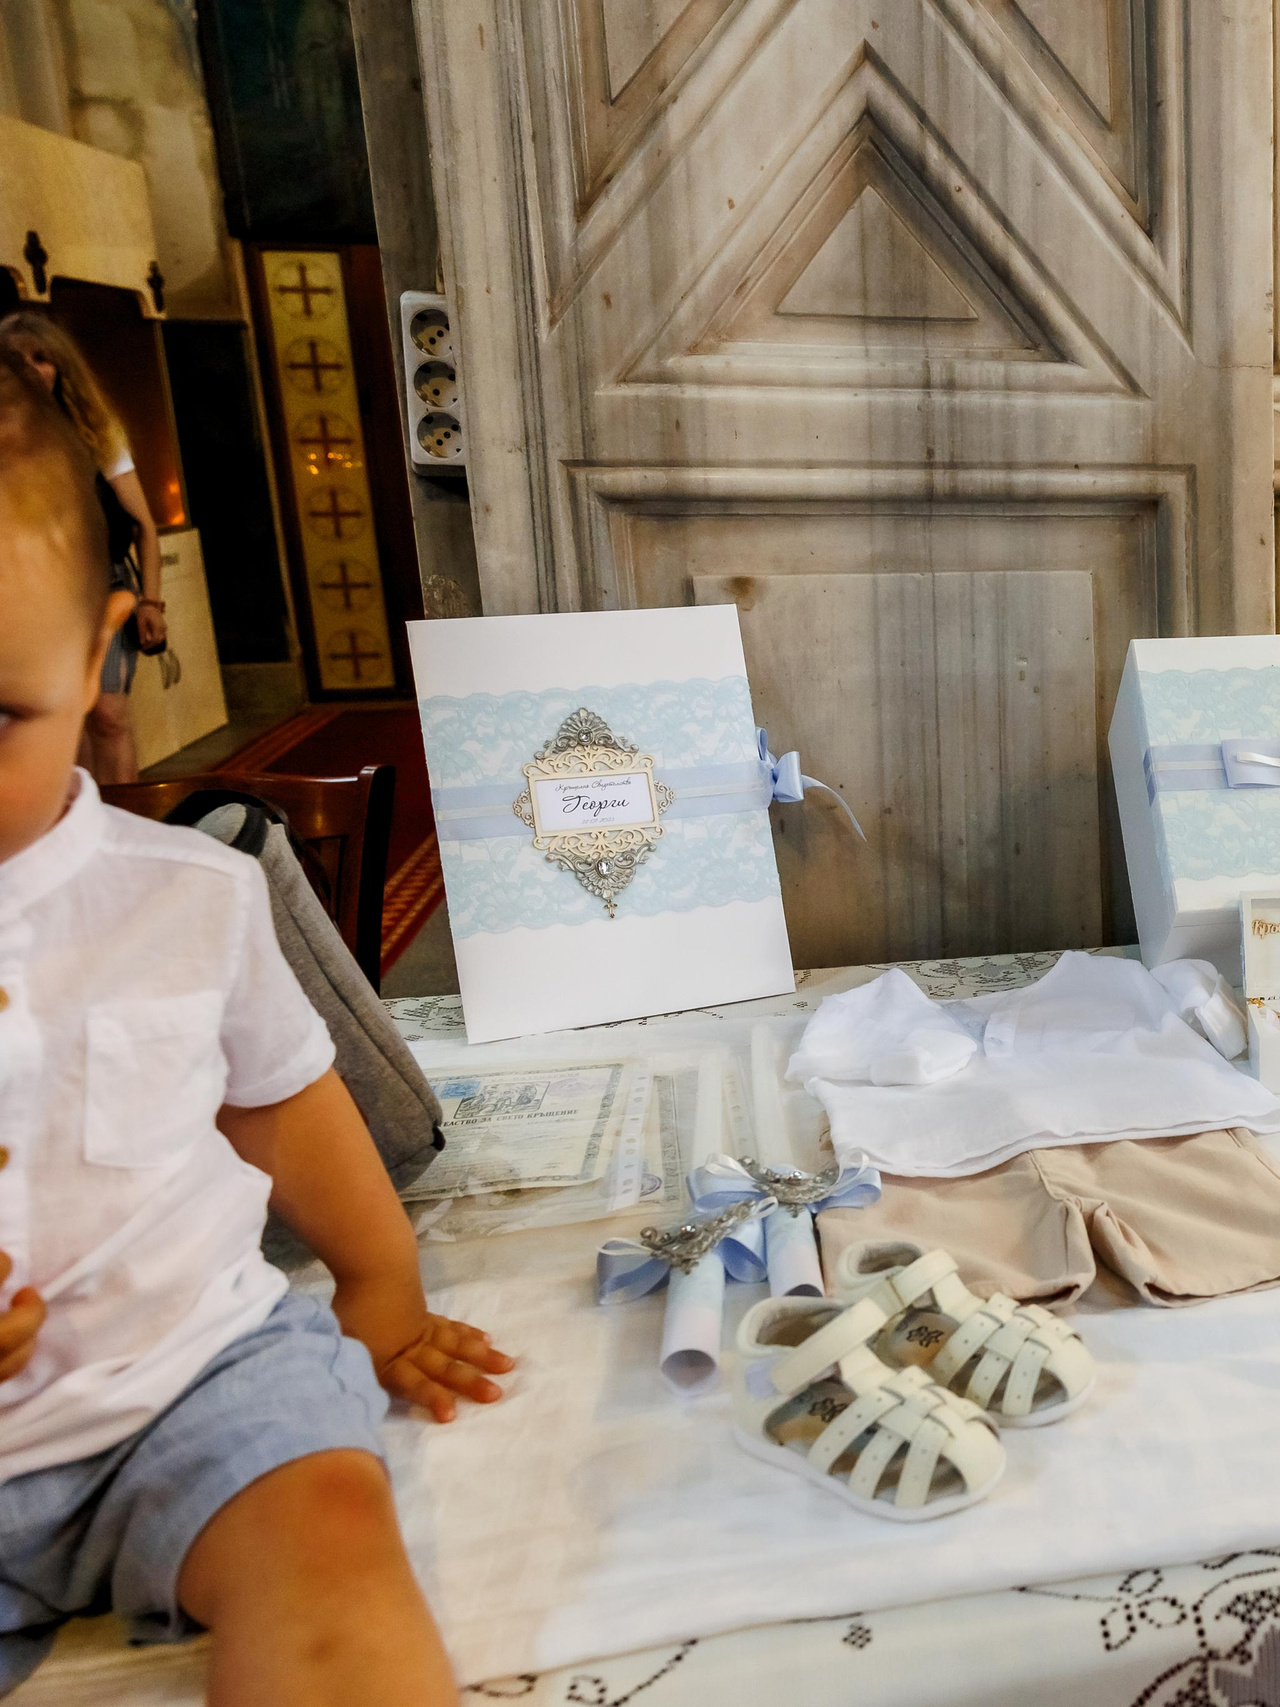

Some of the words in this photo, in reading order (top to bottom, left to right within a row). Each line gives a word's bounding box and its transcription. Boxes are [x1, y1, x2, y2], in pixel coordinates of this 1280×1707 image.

[562, 795, 630, 817] Георги
[443, 1118, 478, 1127] ЕЛСТВО
[526, 1109, 579, 1119] КРЪЩЕНИЕ
